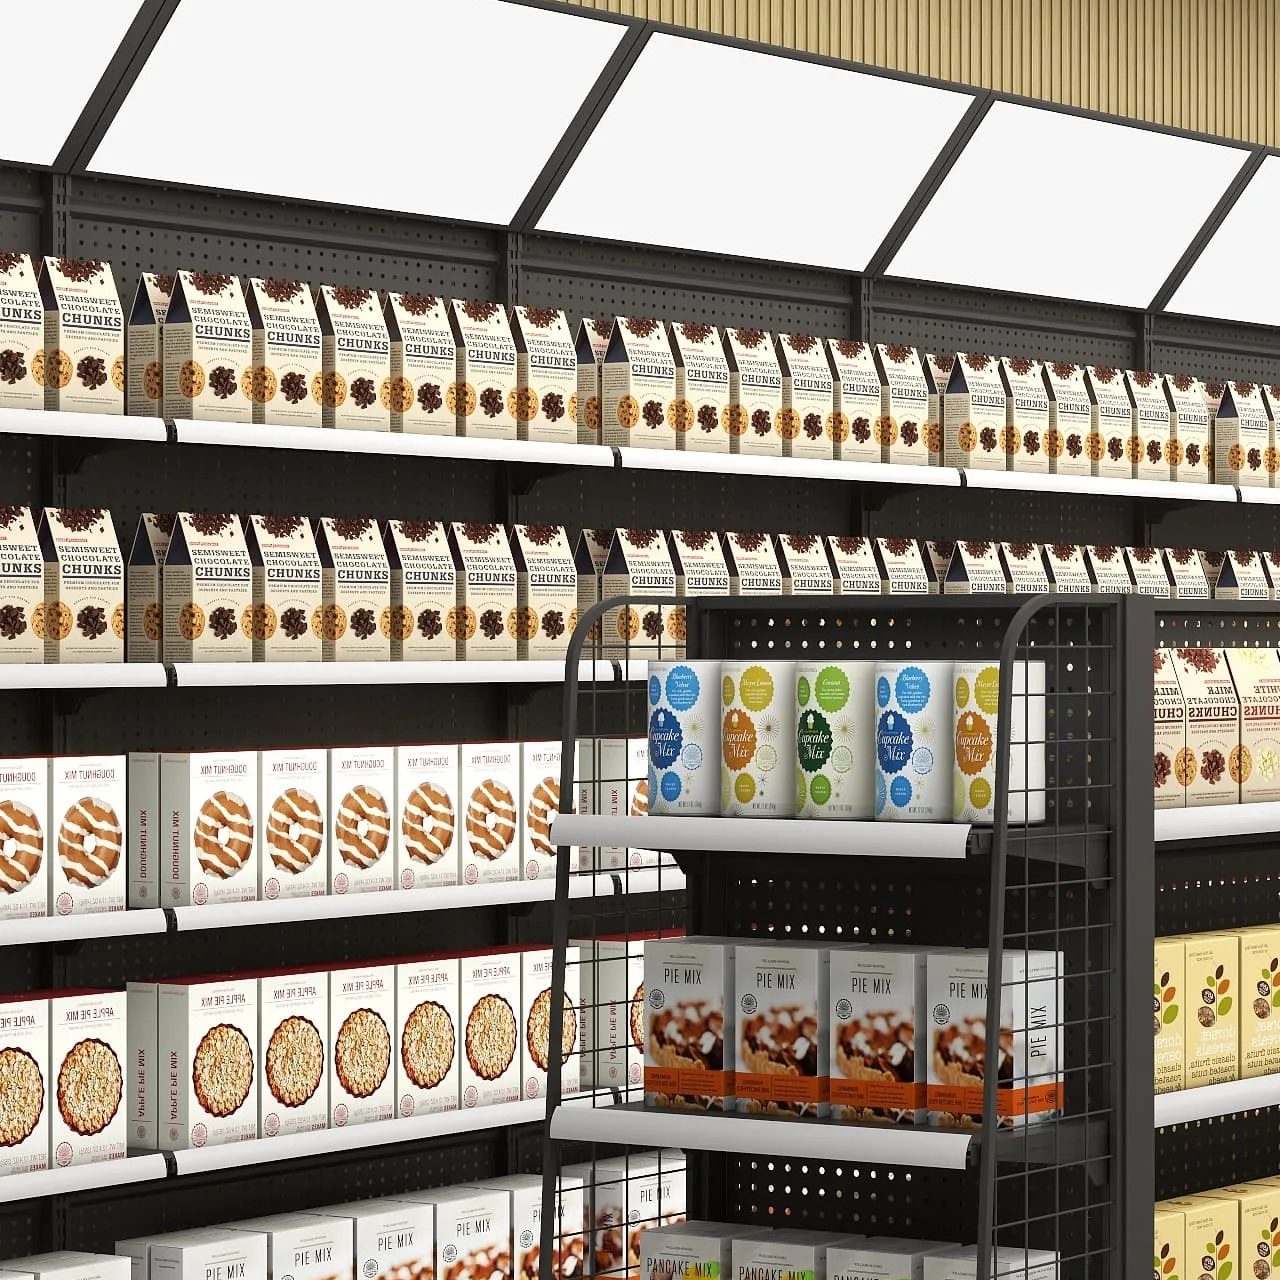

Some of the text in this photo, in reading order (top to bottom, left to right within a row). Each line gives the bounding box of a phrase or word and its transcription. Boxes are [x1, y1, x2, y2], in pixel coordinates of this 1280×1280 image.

[59, 294, 117, 306] SEMISWEET
[2, 309, 41, 320] UNKS
[61, 304, 121, 314] CHOCOLATE
[192, 307, 246, 318] SEMISWEET
[63, 313, 121, 327] CHUNKS
[194, 316, 249, 327] CHOCOLATE
[264, 314, 316, 324] SEMISWEET
[195, 325, 250, 338] CHUNKS
[266, 323, 320, 333] CHOCOLATE
[268, 332, 320, 344] CHUNKS
[338, 338, 388, 350] CHUNKS
[405, 343, 454, 357] CHUNKS
[468, 350, 515, 361] CHUNKS
[531, 355, 576, 367] CHUNKS
[632, 364, 674, 376] CHUNKS
[971, 394, 1005, 405] CHUNKS
[59, 545, 117, 554] SEMISWEET
[192, 549, 246, 557] SEMISWEET
[61, 554, 121, 563] CHOCOLATE
[194, 558, 249, 566] CHOCOLATE
[63, 564, 121, 575] CHUNKS
[195, 567, 250, 578] CHUNKS
[724, 730, 753, 745] Cupcake
[798, 730, 829, 746] Cupcake
[878, 731, 909, 748] Cupcake
[957, 732, 989, 748] Cupcake
[655, 744, 675, 757] Mix
[729, 744, 749, 758] Mix
[803, 745, 824, 759] Mix
[884, 746, 905, 760] Mix
[963, 747, 984, 762] Mix
[664, 968, 701, 984] PIE MIX
[757, 973, 795, 989] PIE MIX
[852, 978, 891, 994] PIE MIX
[950, 983, 965, 998] PIE
[1030, 1005, 1047, 1058] PIE MIX
[456, 1218, 490, 1237] PIE MIX
[378, 1232, 413, 1251] PIE MIX
[294, 1247, 332, 1267] PIE MIX
[228, 1263, 245, 1279] MIX
[647, 1258, 712, 1278] PANCAKE MIX
